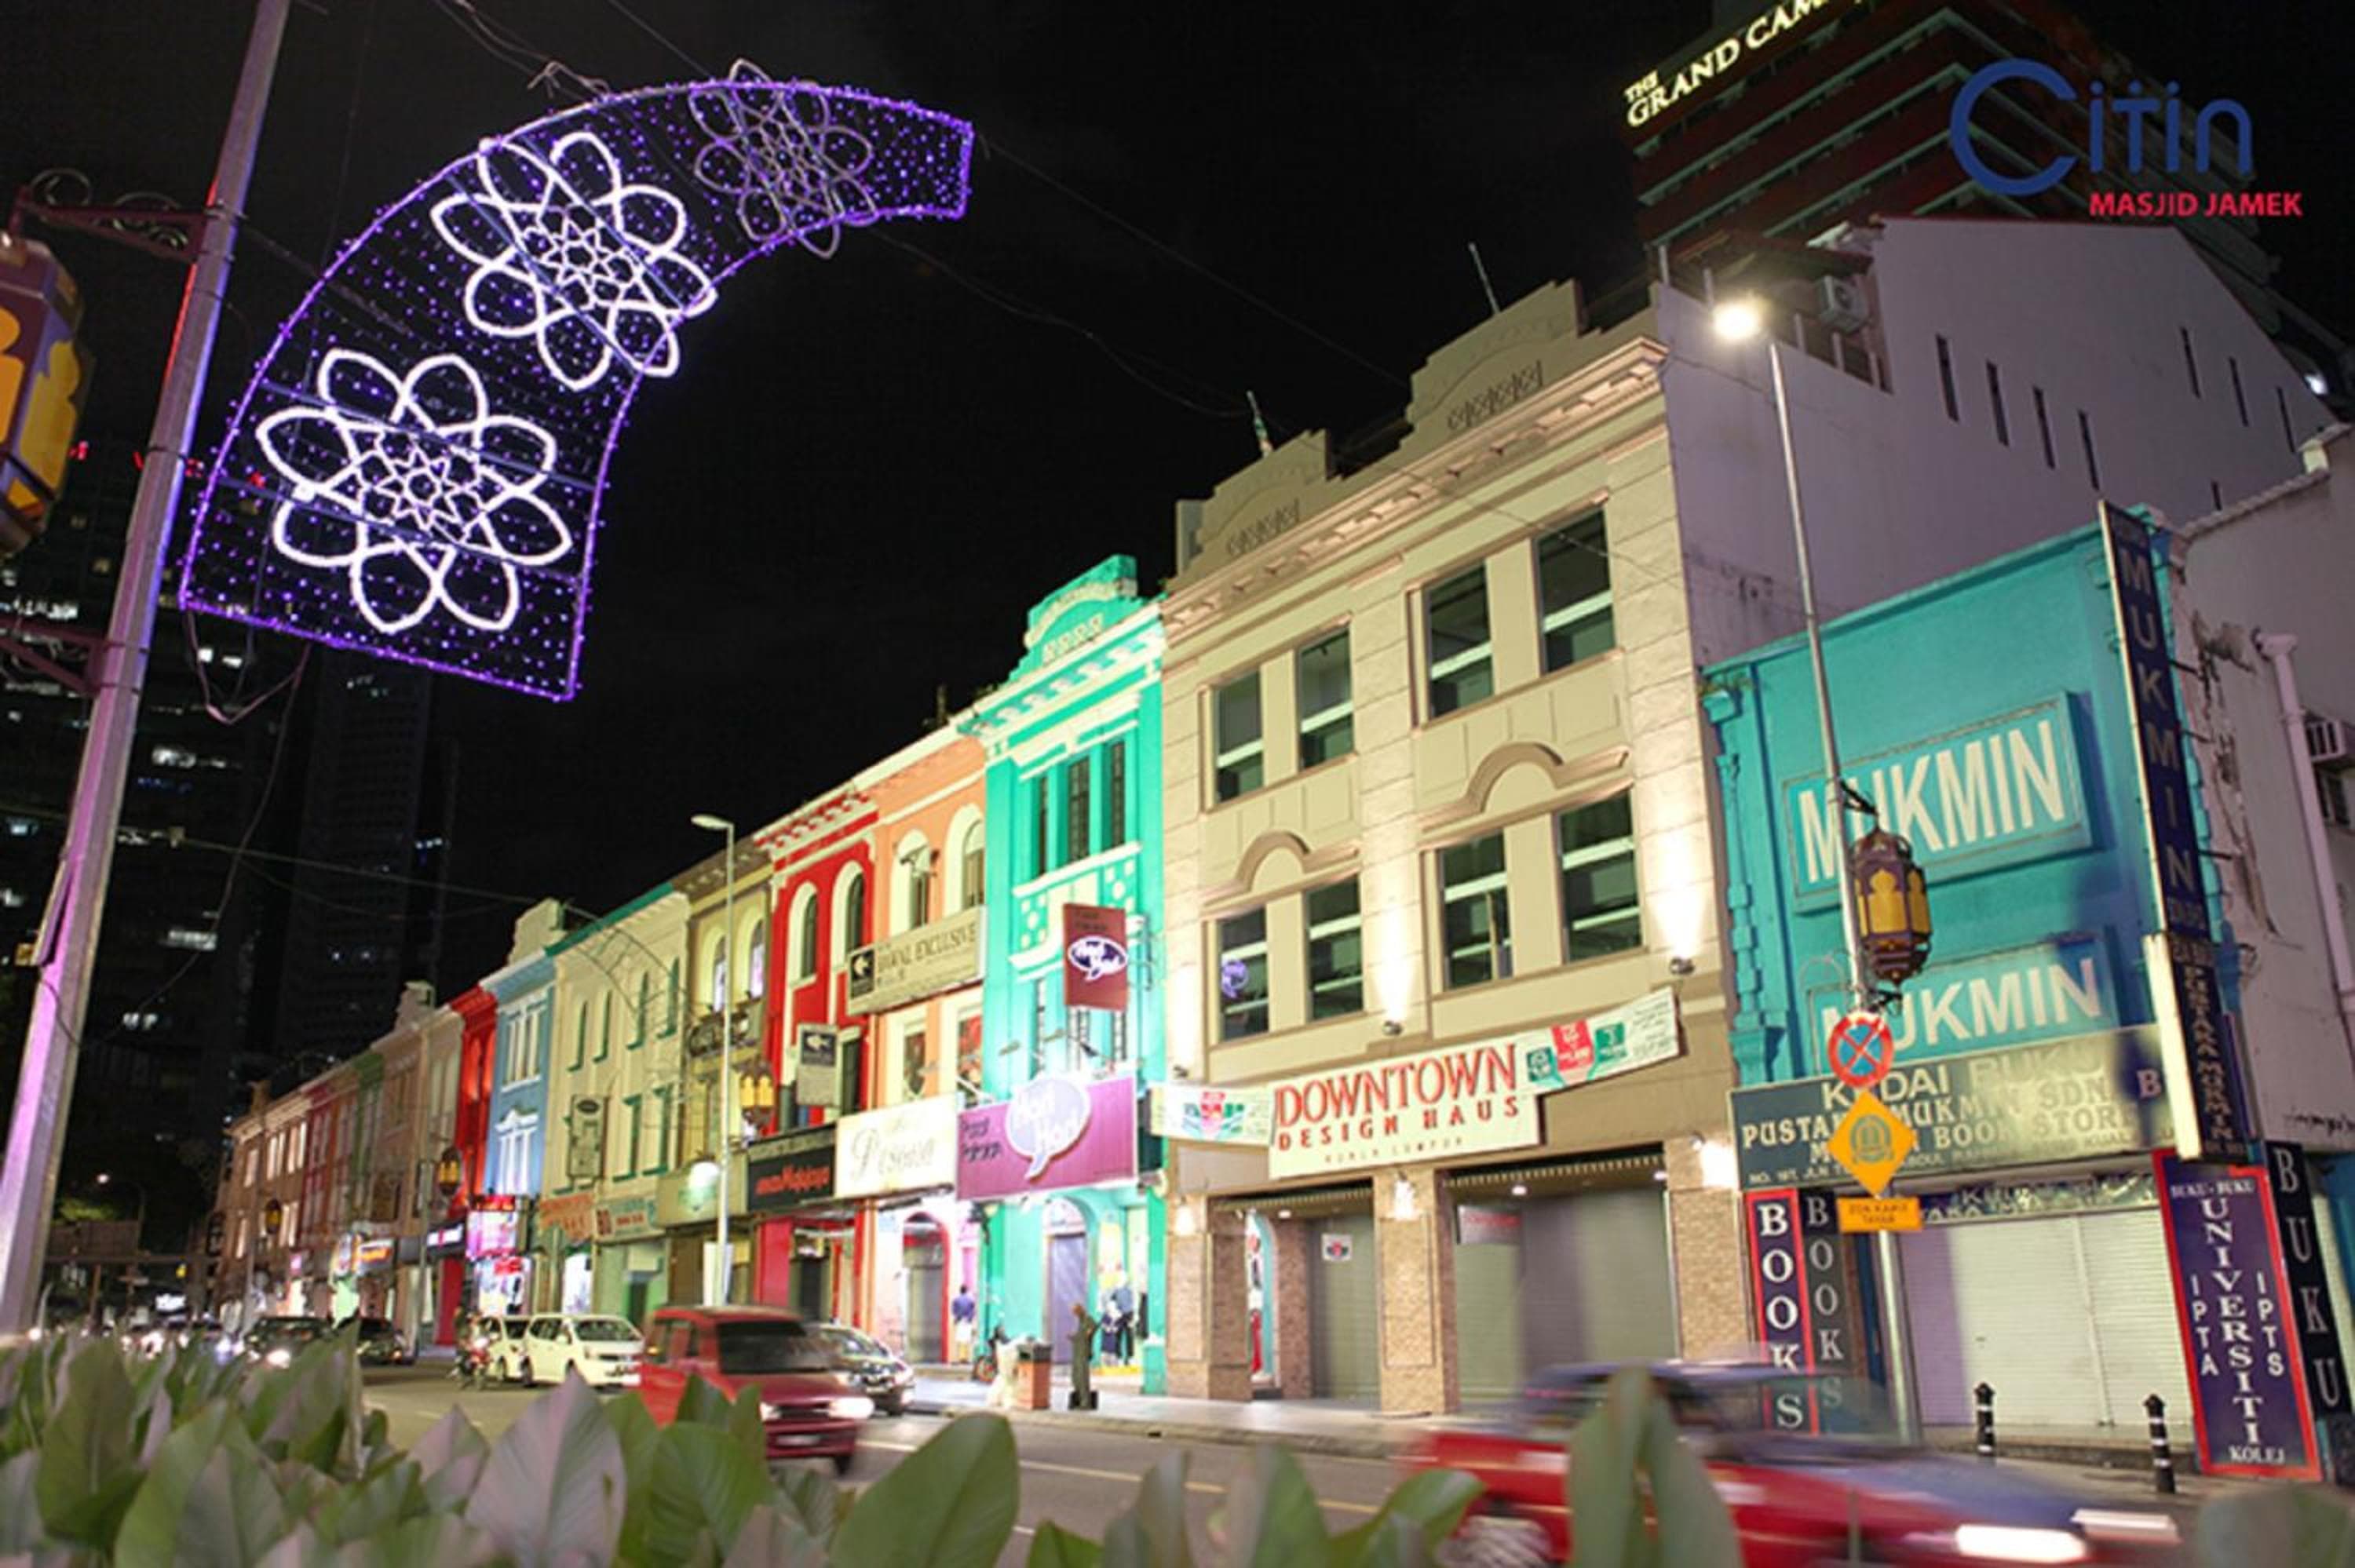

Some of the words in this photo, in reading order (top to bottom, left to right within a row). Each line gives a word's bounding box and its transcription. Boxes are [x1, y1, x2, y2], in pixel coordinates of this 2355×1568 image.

[1627, 38, 1740, 127] GRAND
[2120, 548, 2195, 892] MUKMIN
[1798, 720, 2065, 884] MUKMIN
[1821, 957, 2102, 1053] UKMIN
[1275, 1042, 1517, 1129] DOWNTOWN
[1278, 1114, 1398, 1151] DESIGN
[1423, 1096, 1520, 1130] HAUS
[2039, 1075, 2112, 1110] SDN
[1758, 1202, 1805, 1429] BOOKS
[1807, 1195, 1844, 1408] BOOKS
[2190, 1274, 2220, 1377] IPTA
[2201, 1197, 2264, 1446] UNIVERSITI
[2256, 1271, 2284, 1377] IPTS
[2273, 1147, 2342, 1407] BUKU
[2228, 1445, 2287, 1465] KOLEJ
